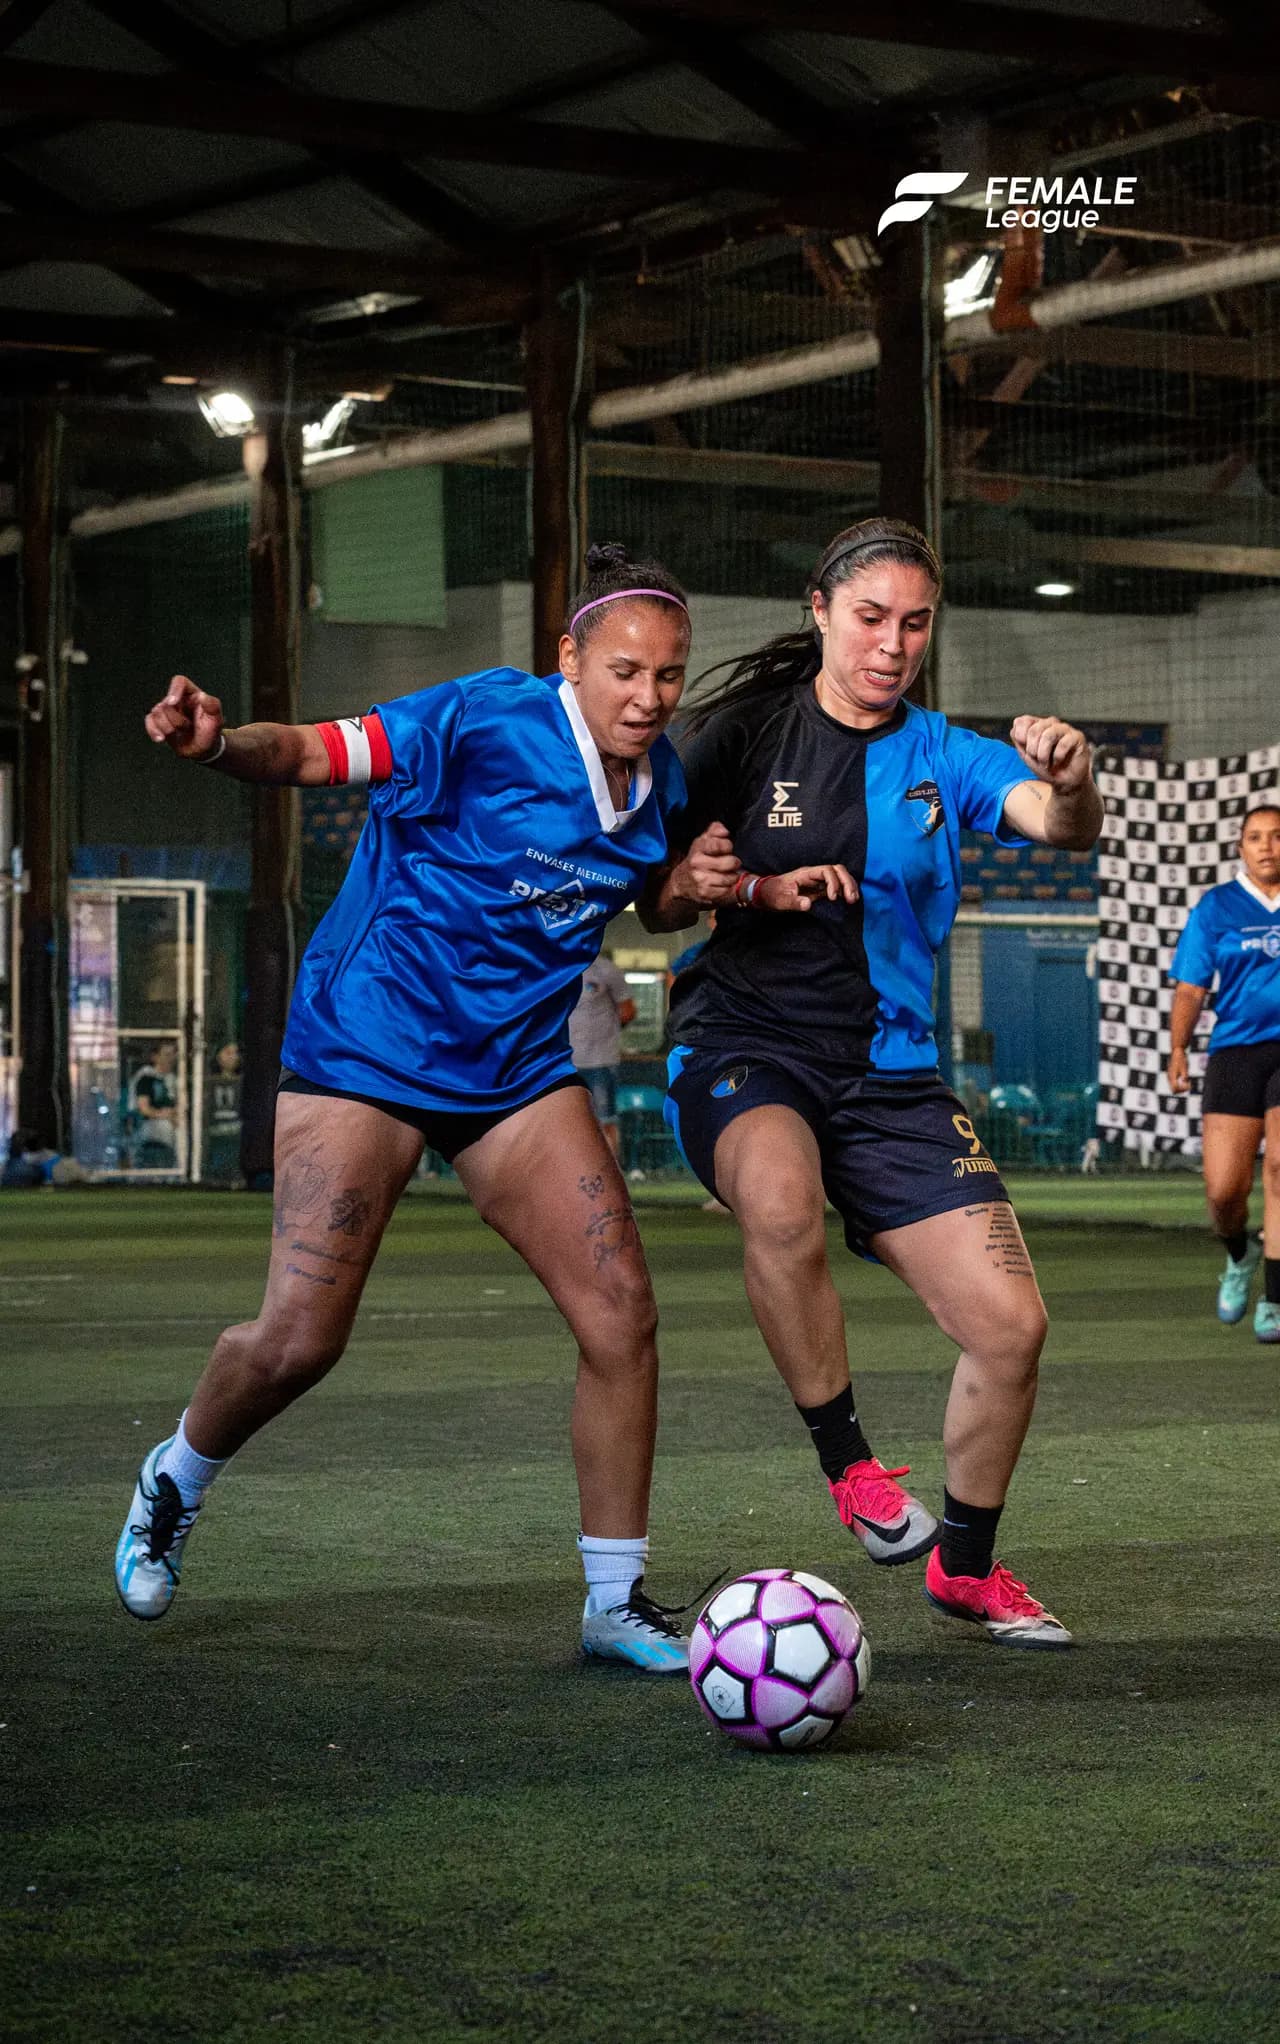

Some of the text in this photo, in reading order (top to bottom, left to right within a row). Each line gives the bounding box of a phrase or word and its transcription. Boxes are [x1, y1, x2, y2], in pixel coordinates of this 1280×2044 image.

[767, 812, 803, 828] ELITE
[526, 847, 575, 873] ENVASES
[952, 1114, 980, 1154] 9
